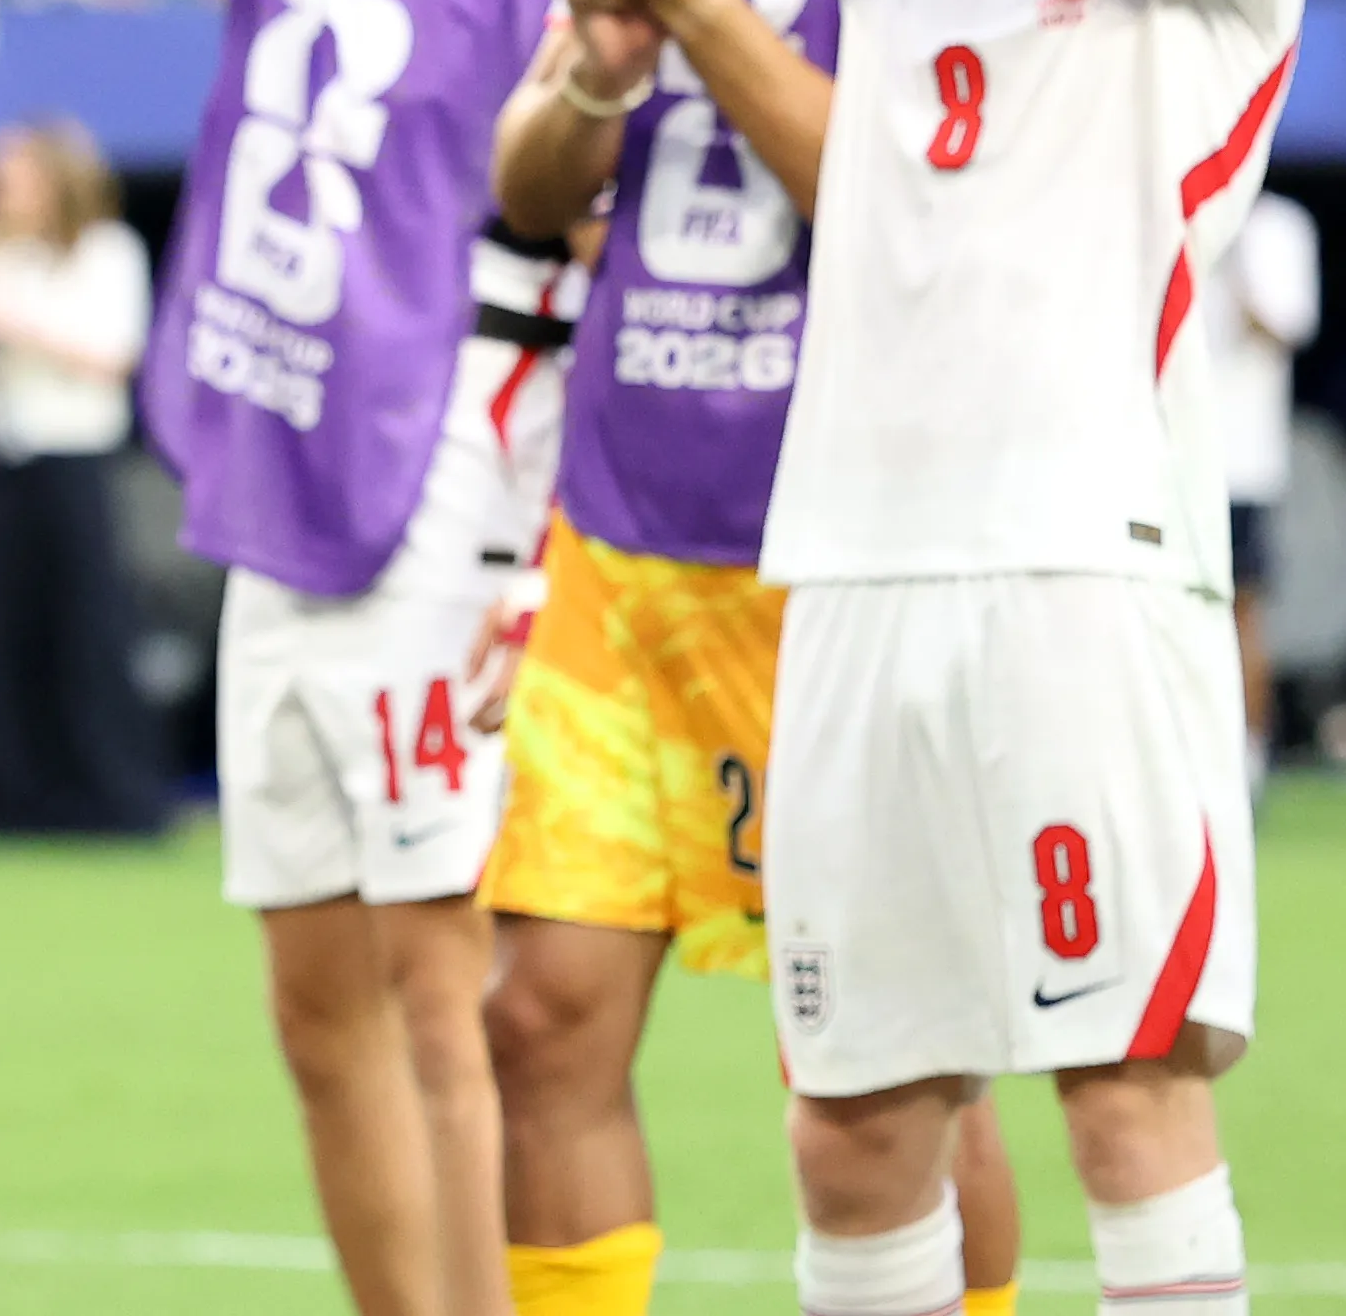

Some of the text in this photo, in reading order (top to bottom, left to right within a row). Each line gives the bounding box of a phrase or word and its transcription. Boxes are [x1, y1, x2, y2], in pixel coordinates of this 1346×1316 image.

[926, 45, 987, 172] 8
[614, 326, 797, 392] 2026
[374, 674, 467, 803] 14
[1033, 824, 1100, 960] 8
